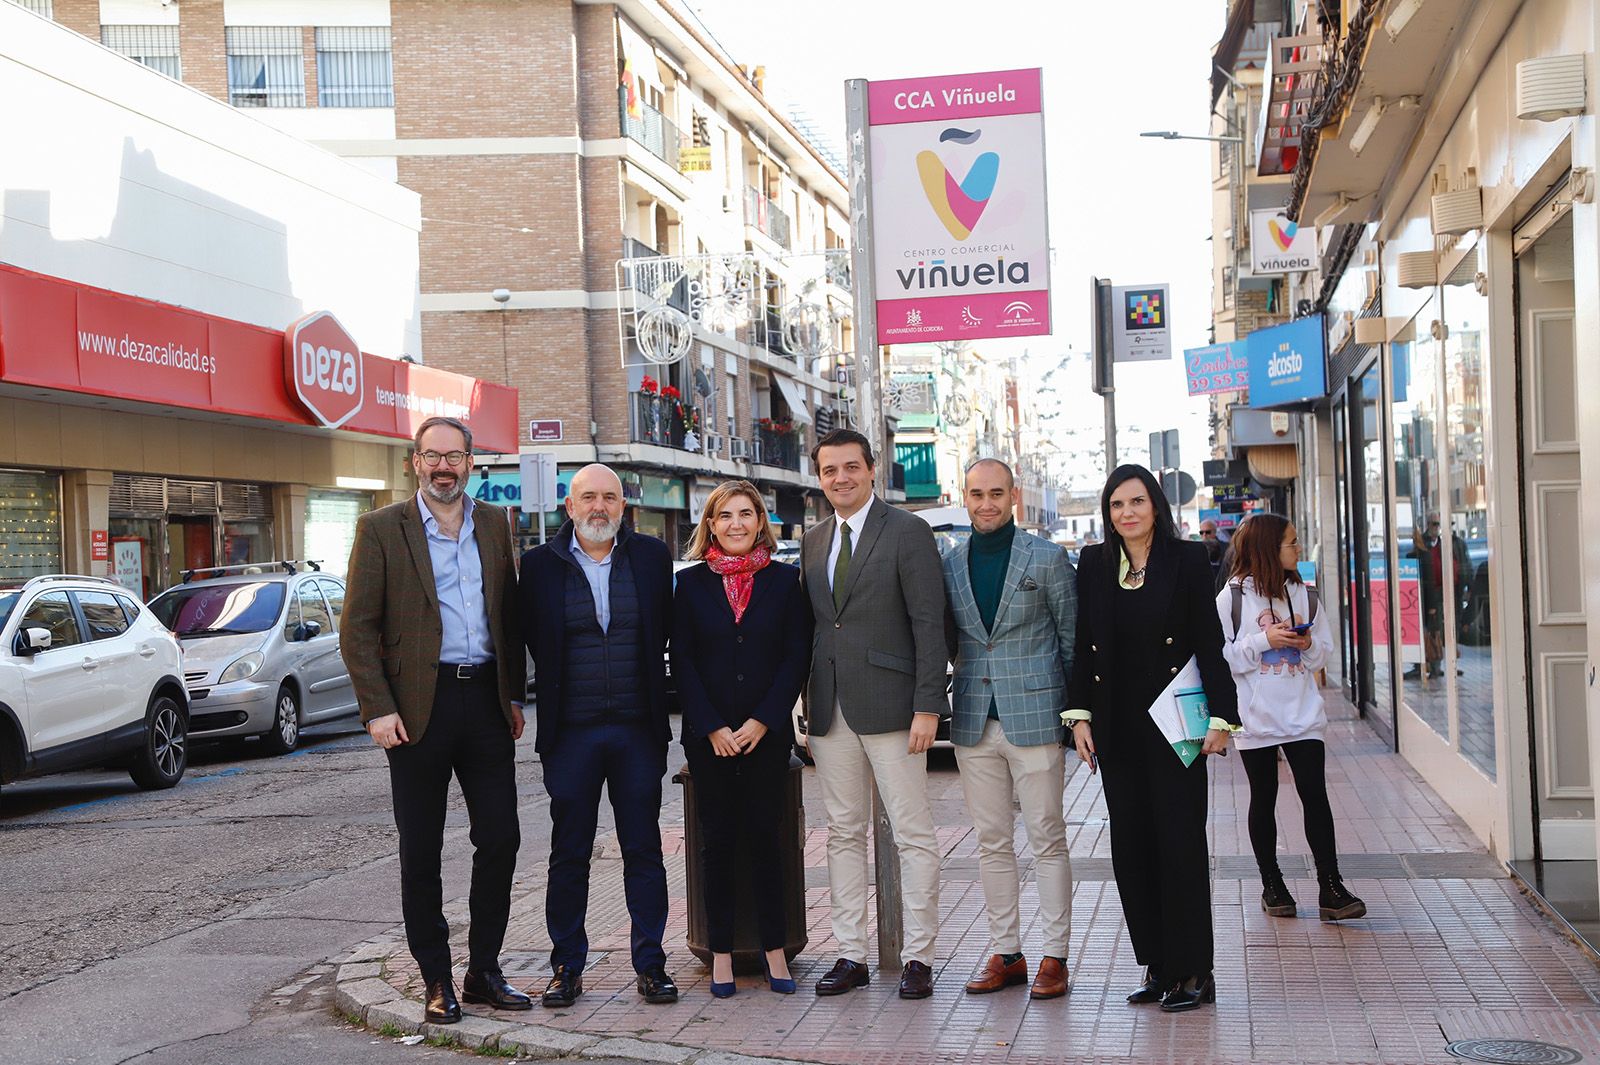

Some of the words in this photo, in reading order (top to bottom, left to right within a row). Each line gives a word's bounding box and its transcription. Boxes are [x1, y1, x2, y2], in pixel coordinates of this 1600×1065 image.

[894, 91, 935, 110] CCA
[942, 83, 1016, 106] Viñuela
[904, 248, 946, 258] CENTRO
[951, 244, 1016, 255] COMERCIAL
[896, 256, 1030, 290] viñuela
[78, 330, 216, 374] www.dezacalidad.es
[1268, 349, 1302, 378] alcosto
[1235, 371, 1249, 385] 5
[376, 385, 411, 410] tenemos
